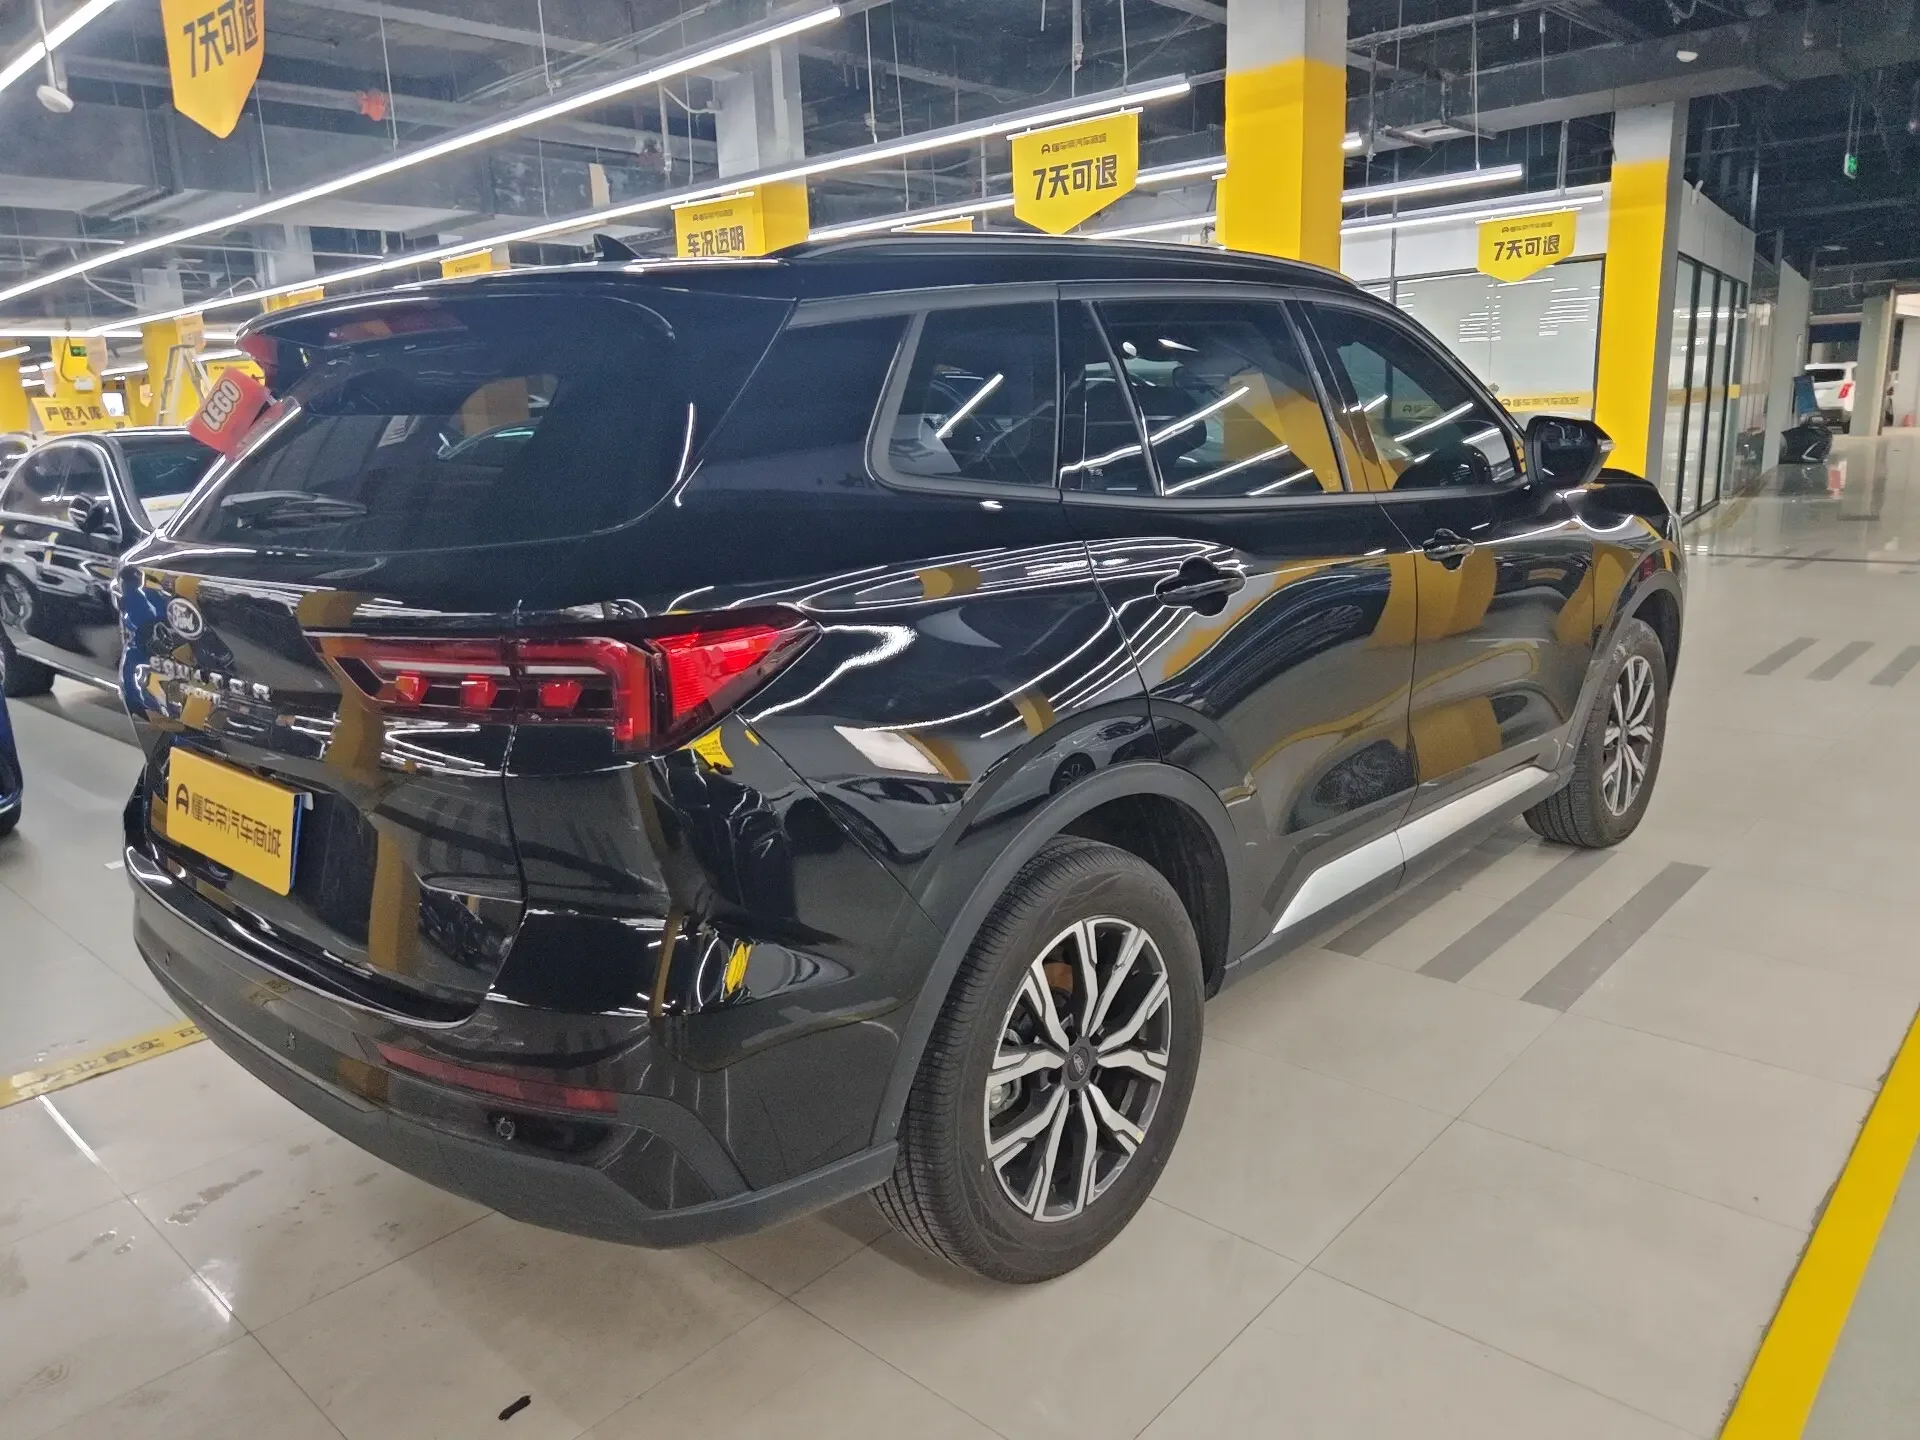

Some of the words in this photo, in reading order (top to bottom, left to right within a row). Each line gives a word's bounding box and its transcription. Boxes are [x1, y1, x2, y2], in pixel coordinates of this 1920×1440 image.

[183, 0, 258, 77] 7天可退
[1032, 154, 1118, 200] 7天可退
[686, 225, 745, 256] 车况透明
[1493, 234, 1561, 261] 7天可退
[200, 379, 242, 433] LEGO
[171, 600, 197, 633] Ford
[192, 791, 282, 858] 懂车帝汽车商城
